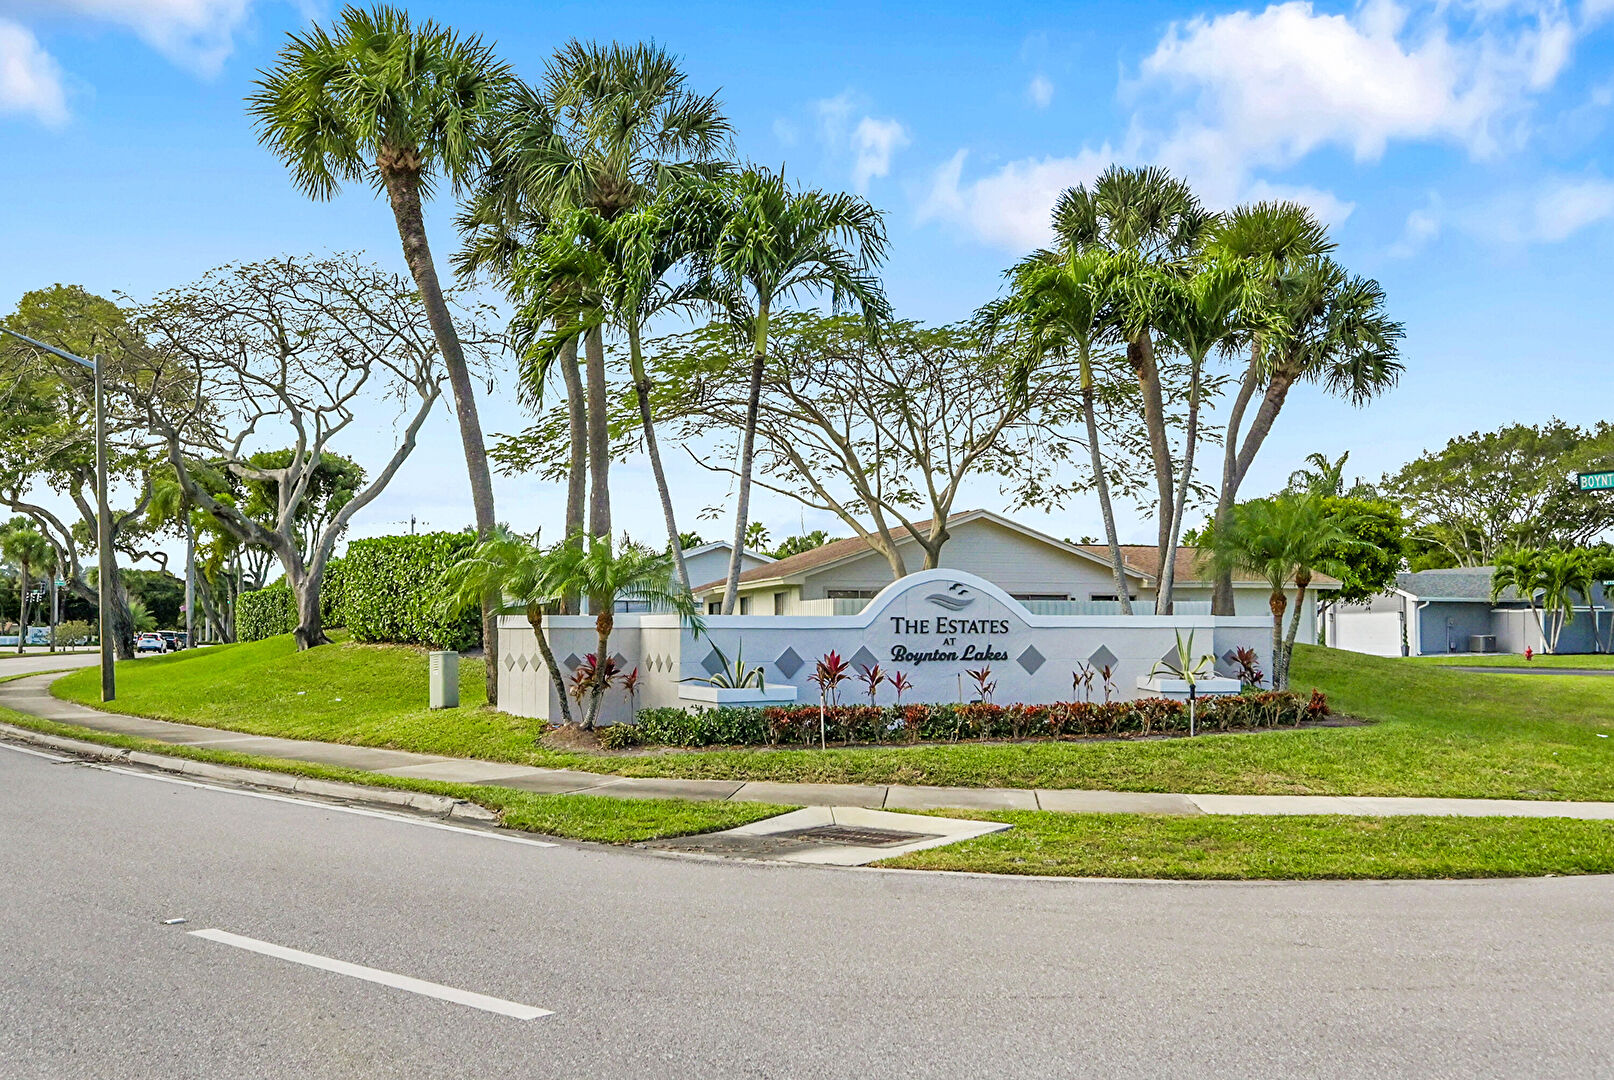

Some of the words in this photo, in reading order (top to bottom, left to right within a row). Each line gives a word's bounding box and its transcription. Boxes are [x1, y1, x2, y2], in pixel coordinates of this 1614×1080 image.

[1581, 474, 1614, 488] BOYNT
[890, 617, 929, 634] THE
[936, 617, 1009, 634] ESTATES
[891, 645, 958, 666] Boynton
[960, 644, 1008, 661] Lakes
